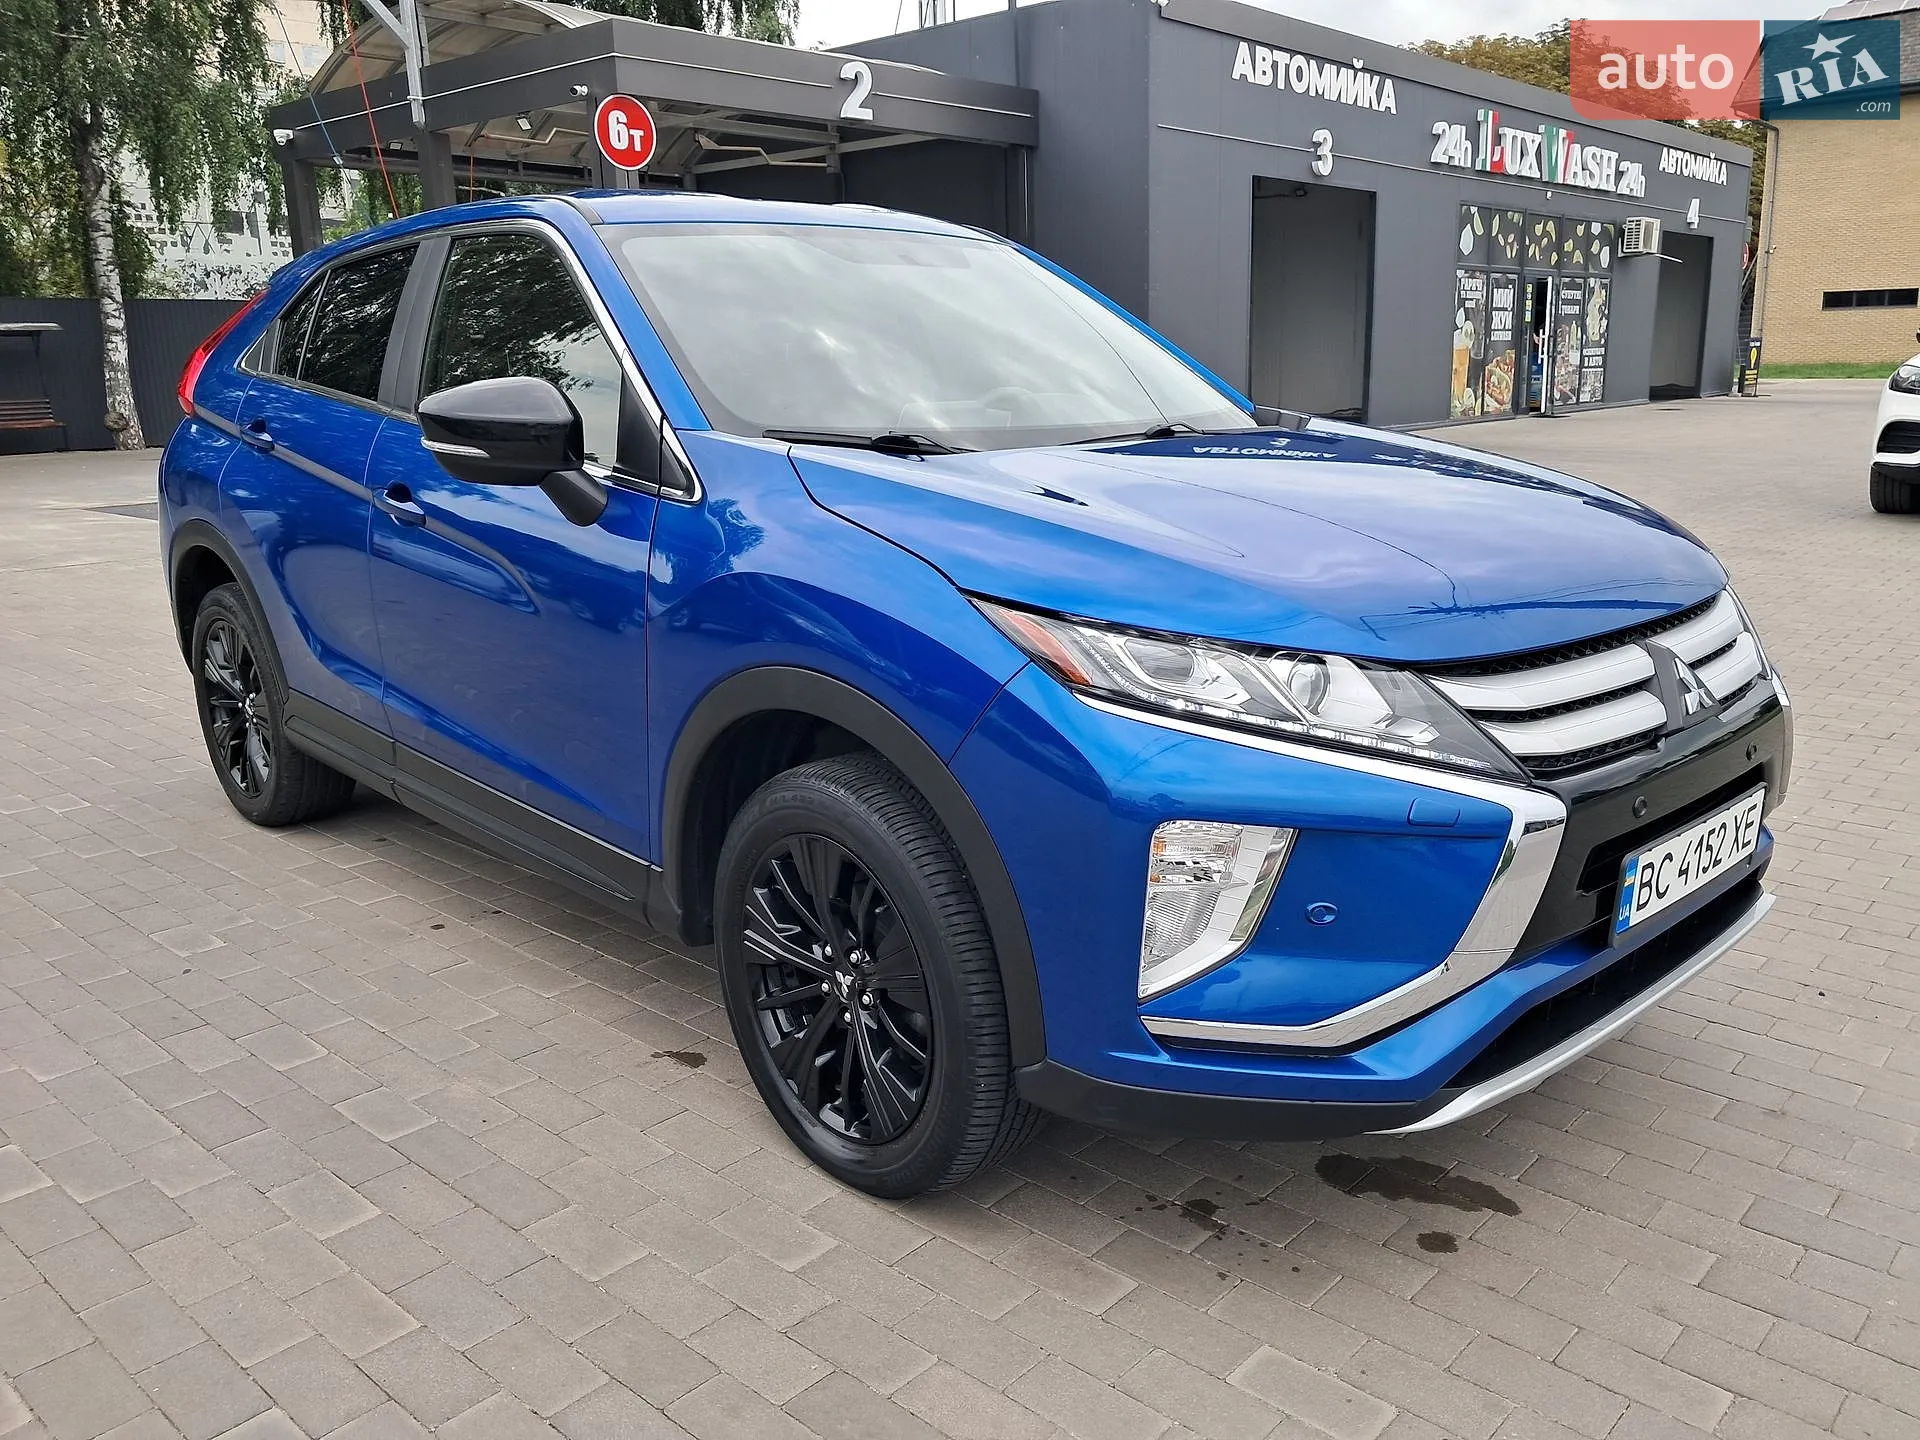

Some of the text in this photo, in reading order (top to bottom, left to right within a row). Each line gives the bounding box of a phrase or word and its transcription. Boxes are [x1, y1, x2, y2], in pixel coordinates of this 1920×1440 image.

[839, 61, 874, 121] 2
[1232, 41, 1397, 115] АВТОМИЙКА
[1311, 129, 1333, 176] 3
[1430, 121, 1472, 168] 24h
[1616, 161, 1646, 198] 24h
[1659, 147, 1728, 186] АВТОМИЙКА
[1686, 198, 1700, 229] 4
[1636, 804, 1758, 913] BC 4152 XE
[1618, 904, 1630, 921] UA
